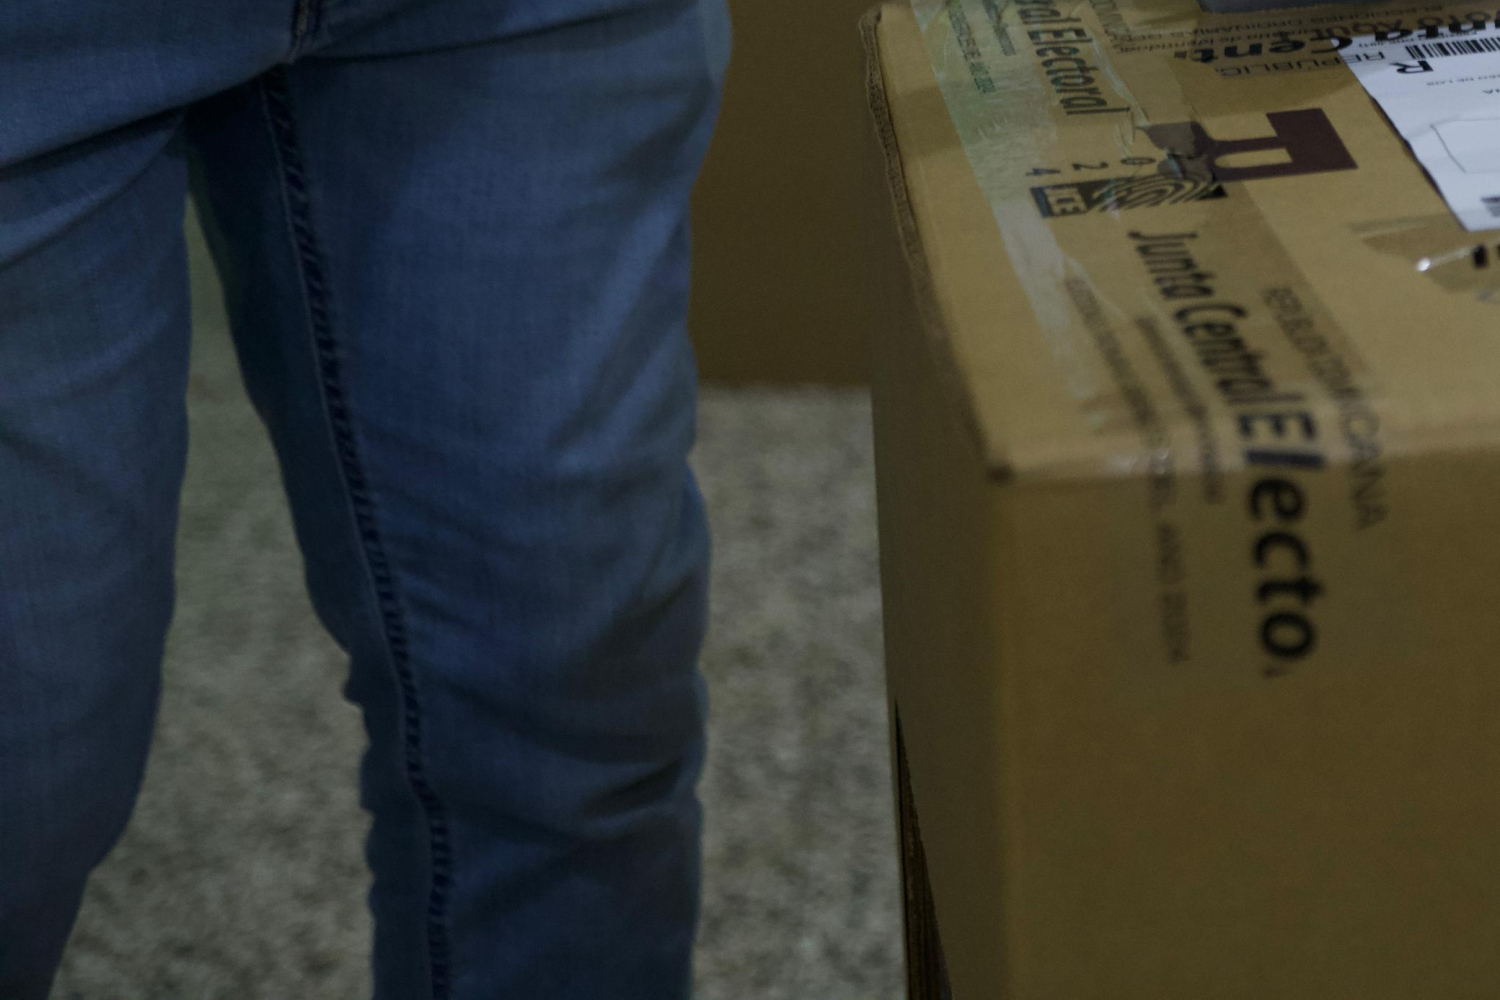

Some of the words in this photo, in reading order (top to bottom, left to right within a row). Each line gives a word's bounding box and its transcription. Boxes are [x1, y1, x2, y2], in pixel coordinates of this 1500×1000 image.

[1026, 26, 1128, 115] Electoral
[1215, 52, 1386, 77] REPÚBLIC
[1390, 61, 1433, 74] R
[1128, 230, 1217, 298] Junta
[1174, 304, 1300, 404] Central
[1239, 411, 1324, 677] Electo
